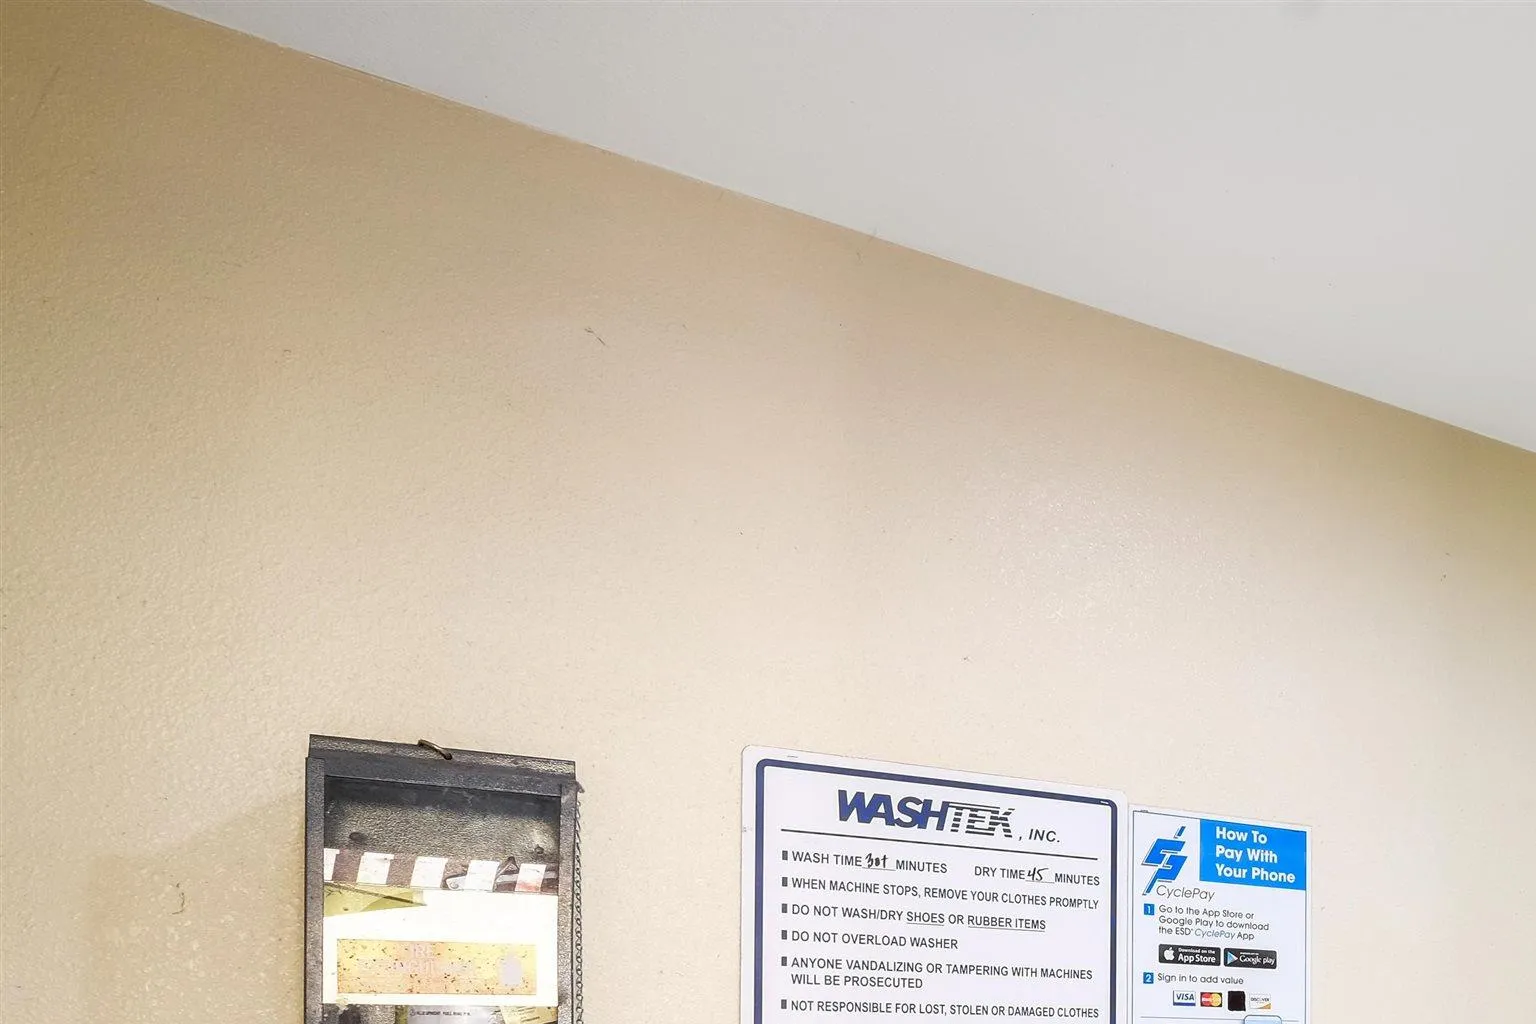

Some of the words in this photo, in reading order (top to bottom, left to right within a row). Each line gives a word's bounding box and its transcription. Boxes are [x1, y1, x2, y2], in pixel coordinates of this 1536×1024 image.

[1029, 829, 1060, 843] INC.
[1216, 826, 1248, 843] How
[1252, 831, 1267, 844] To
[792, 851, 829, 863] WASH
[833, 854, 862, 867] TIME
[896, 860, 947, 873] MINUTES
[1216, 845, 1243, 862] Pay
[1247, 848, 1277, 863] With
[974, 866, 996, 877] DRY
[1000, 868, 1025, 879] TIME
[1027, 867, 1048, 881] 45
[1055, 873, 1100, 885] MINUTES
[1216, 864, 1247, 878] Your
[1252, 867, 1295, 883] Phone
[792, 877, 825, 890] WHEN
[830, 881, 879, 894] MACHINE
[883, 885, 920, 898] STOPS,
[924, 887, 968, 901] REMOVE
[971, 891, 998, 902] YOUR
[1002, 893, 1046, 905] CLOTHES
[1050, 898, 1098, 909] PROMPTLY
[1156, 885, 1215, 902] CyclePay
[792, 904, 809, 915] DO
[814, 906, 838, 916] NOT
[842, 907, 903, 920] WASH/DRY
[907, 911, 944, 923] SHOES
[949, 914, 964, 924] OR
[968, 916, 1012, 927] RUBBER
[1015, 919, 1046, 929] ITEMS
[1147, 905, 1151, 914] 1
[1159, 905, 1172, 913] Go
[1175, 907, 1183, 915] to
[1187, 907, 1200, 915] the
[1203, 909, 1220, 918] App
[1223, 910, 1243, 918] Store
[1159, 916, 1192, 926] Google
[1196, 919, 1213, 928] Play
[1216, 919, 1224, 927] to
[1226, 920, 1269, 931] download
[792, 931, 809, 941] DO
[814, 932, 838, 943] NOT
[842, 934, 906, 946] OVERLOAD
[910, 937, 958, 949] WASHER
[1159, 926, 1172, 934] the
[1195, 929, 1235, 940] CyclePay
[1178, 953, 1194, 963] App
[1196, 954, 1216, 963] Store
[1240, 955, 1261, 964] Google
[1263, 957, 1275, 965] play
[791, 957, 842, 969] ANYONE
[846, 960, 922, 972] VANDALIZING
[927, 963, 942, 973] OR
[946, 964, 1008, 976] TAMPERING
[1012, 967, 1037, 977] WITH
[1041, 968, 1092, 979] MACHINES
[791, 974, 820, 985] WILL
[825, 975, 840, 985] BE
[844, 976, 922, 988] PROSECUTED
[1145, 974, 1151, 983] 2
[1158, 973, 1176, 983] Sign
[1179, 973, 1186, 982] in
[1189, 974, 1197, 982] to
[1200, 975, 1218, 983] add
[1221, 976, 1243, 984] value
[792, 1000, 813, 1011] NOT
[817, 1001, 891, 1013] RESPONSIBLE
[896, 1003, 916, 1013] FOR
[919, 1004, 946, 1016] LOST,
[950, 1005, 988, 1015] STOLEN
[992, 1006, 1005, 1015] OR
[1008, 1007, 1054, 1017] DAMAGED
[1057, 1008, 1098, 1017] CLOTHES
